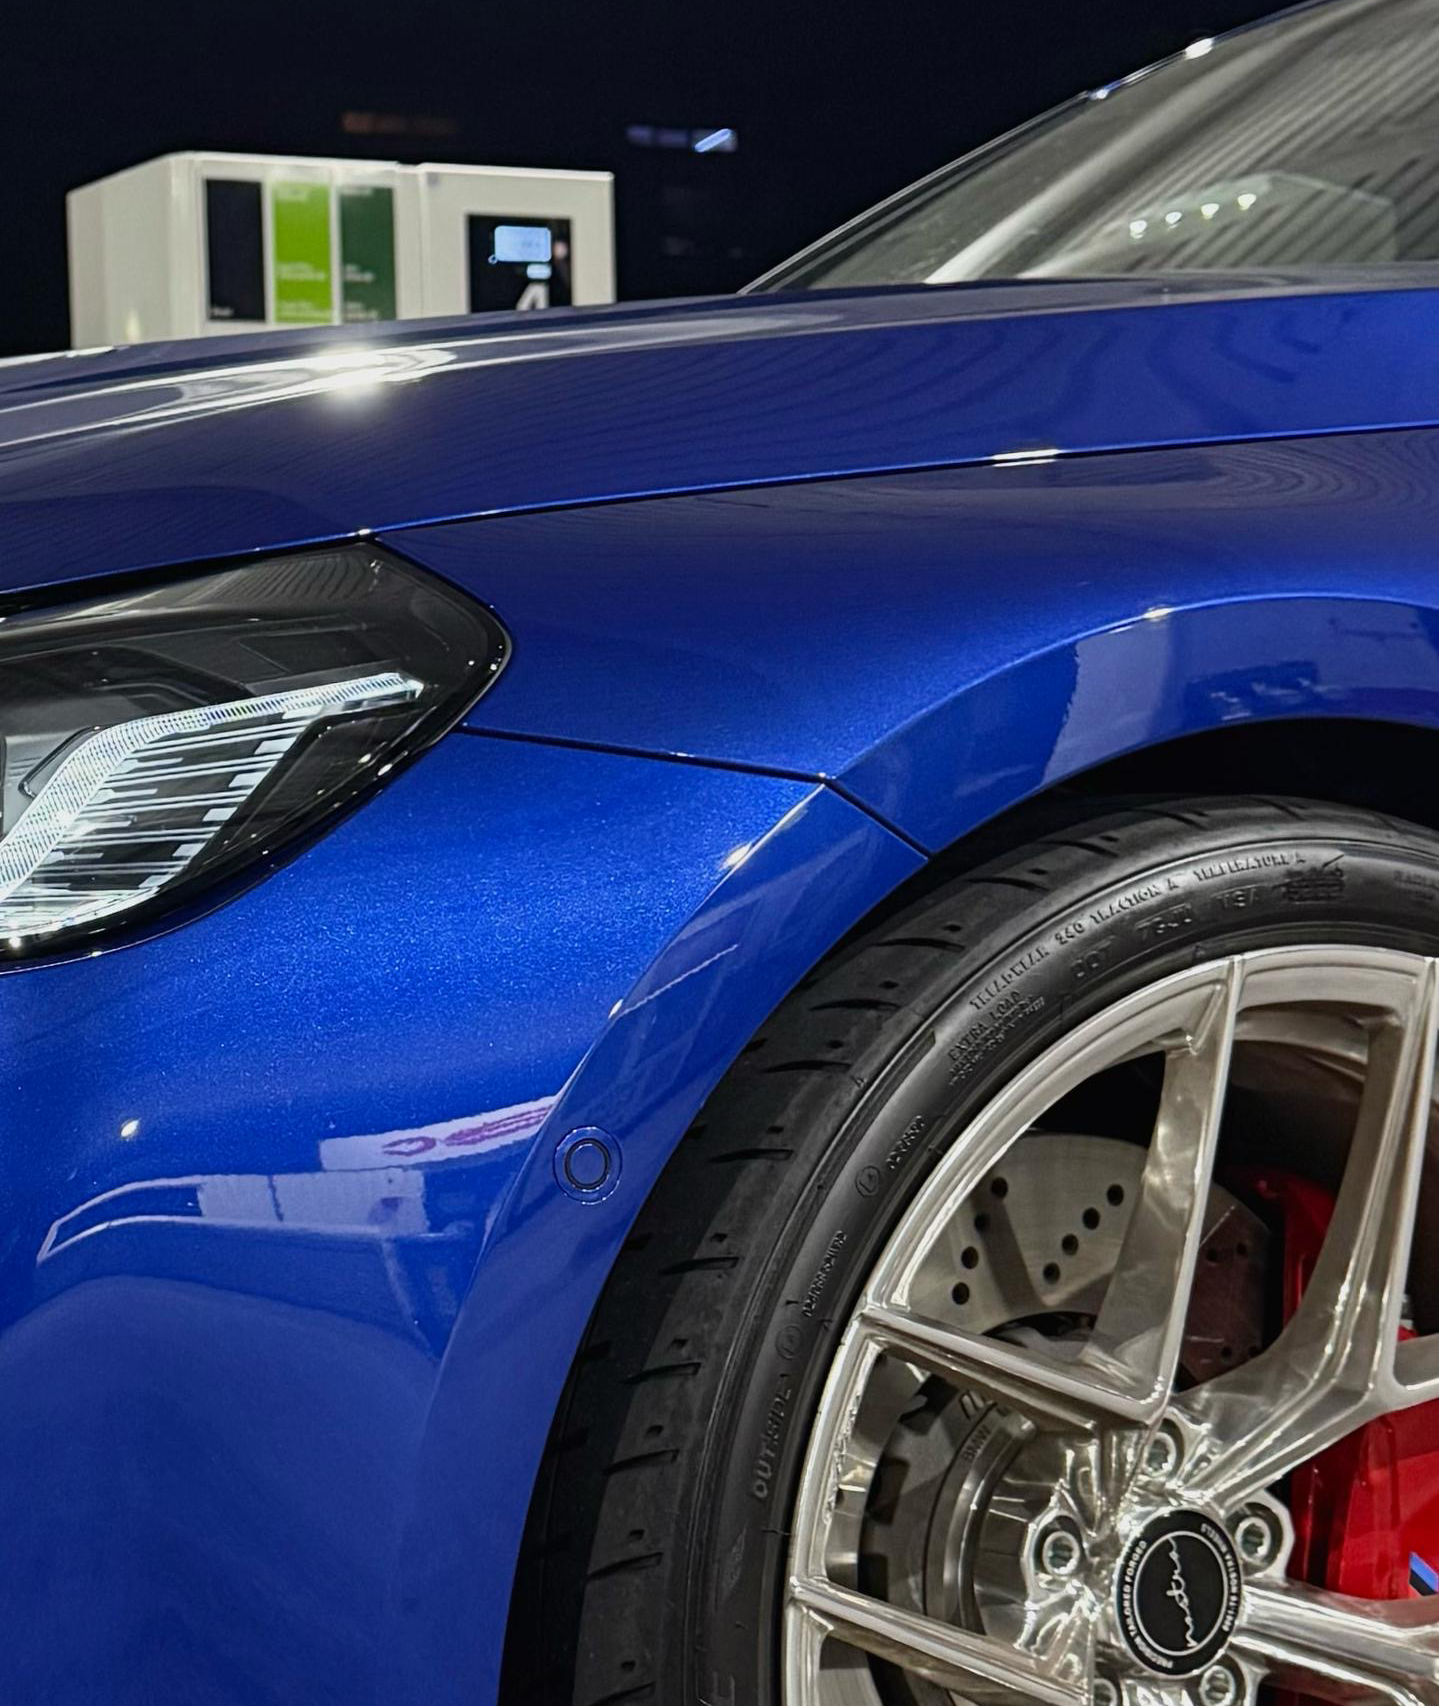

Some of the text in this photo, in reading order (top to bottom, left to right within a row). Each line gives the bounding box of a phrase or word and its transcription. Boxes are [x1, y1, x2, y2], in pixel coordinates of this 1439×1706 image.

[969, 946, 1050, 1010] TREADWEAR
[1090, 883, 1162, 925] TRACTION
[1193, 852, 1290, 882] TEMPERATURE
[948, 990, 1021, 1061] EXTRA LOAD
[753, 1386, 792, 1499] OUTSIDE
[962, 1425, 991, 1462] BMW
[1124, 1540, 1148, 1583] FORGED
